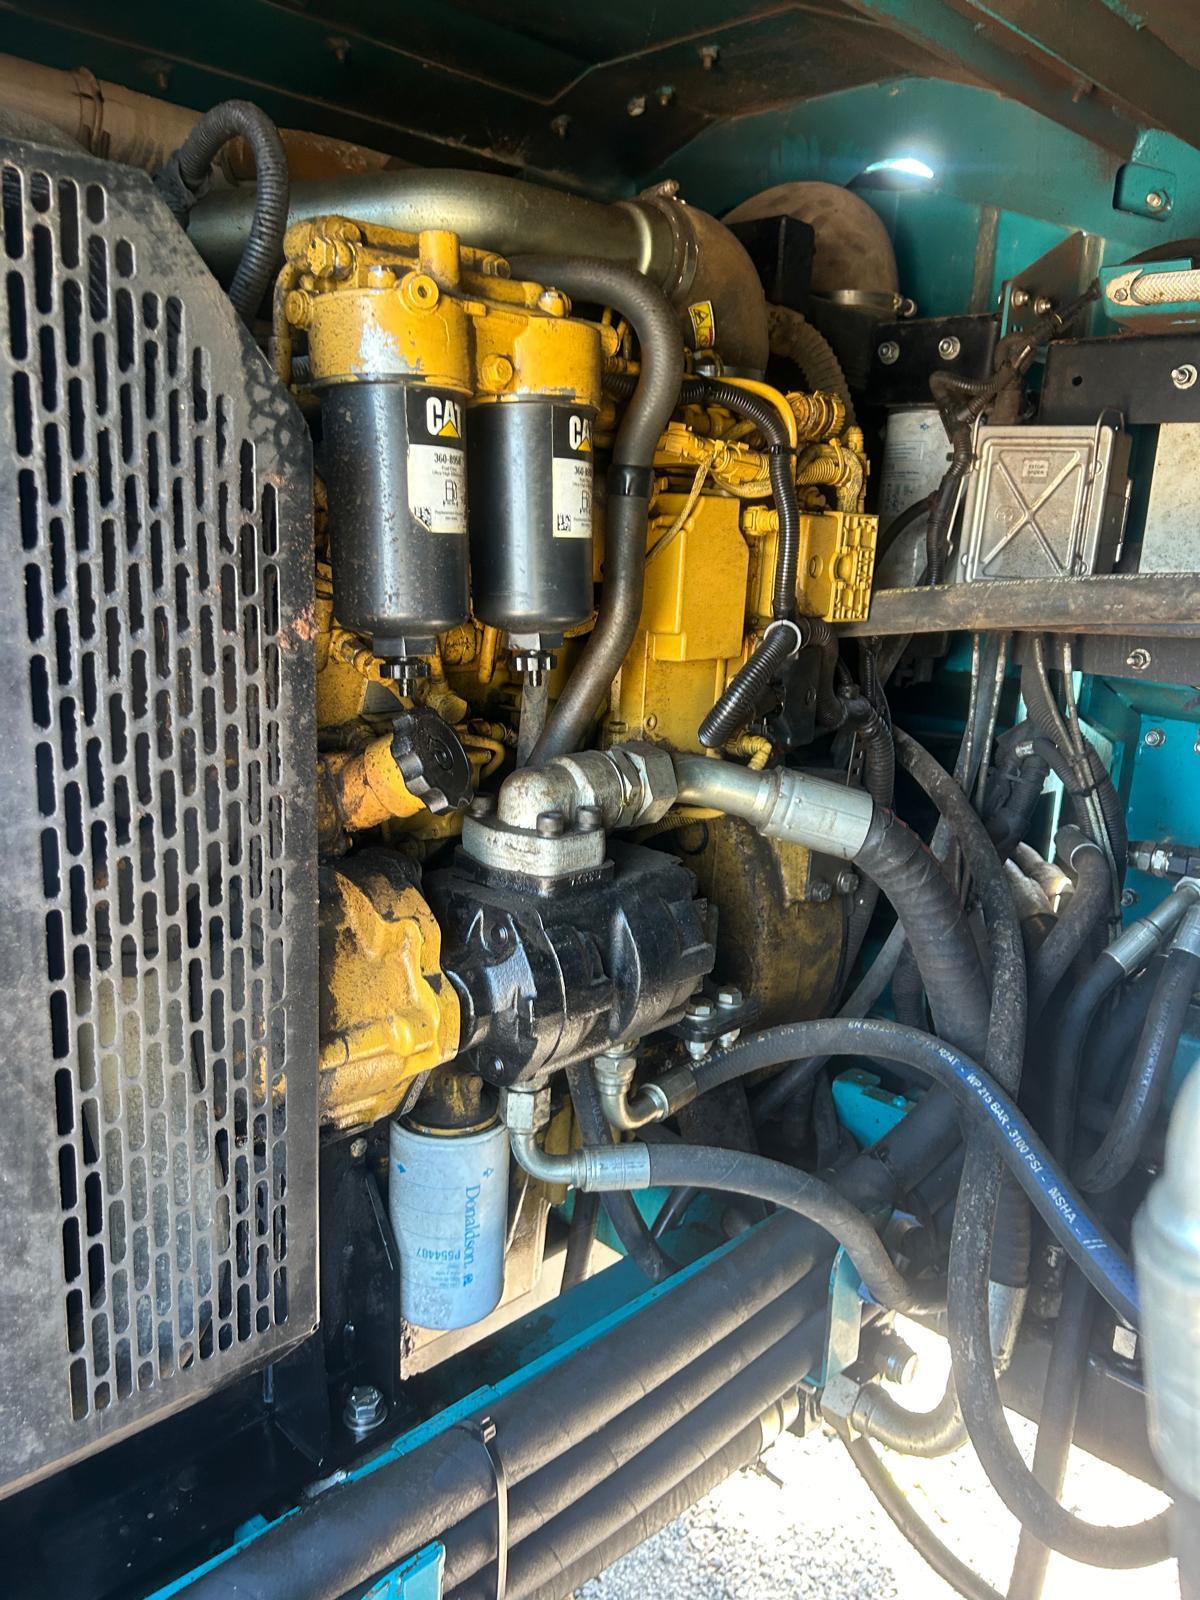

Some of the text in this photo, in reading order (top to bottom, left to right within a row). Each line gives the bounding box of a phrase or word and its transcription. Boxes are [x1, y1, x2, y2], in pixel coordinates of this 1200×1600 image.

[426, 396, 462, 439] CAT
[569, 415, 592, 450] CA
[966, 1072, 982, 1088] WP
[978, 1086, 993, 1105] 215
[991, 1102, 1010, 1126] BAR
[1009, 1129, 1030, 1154] 3100
[1025, 1153, 1044, 1173] PSI
